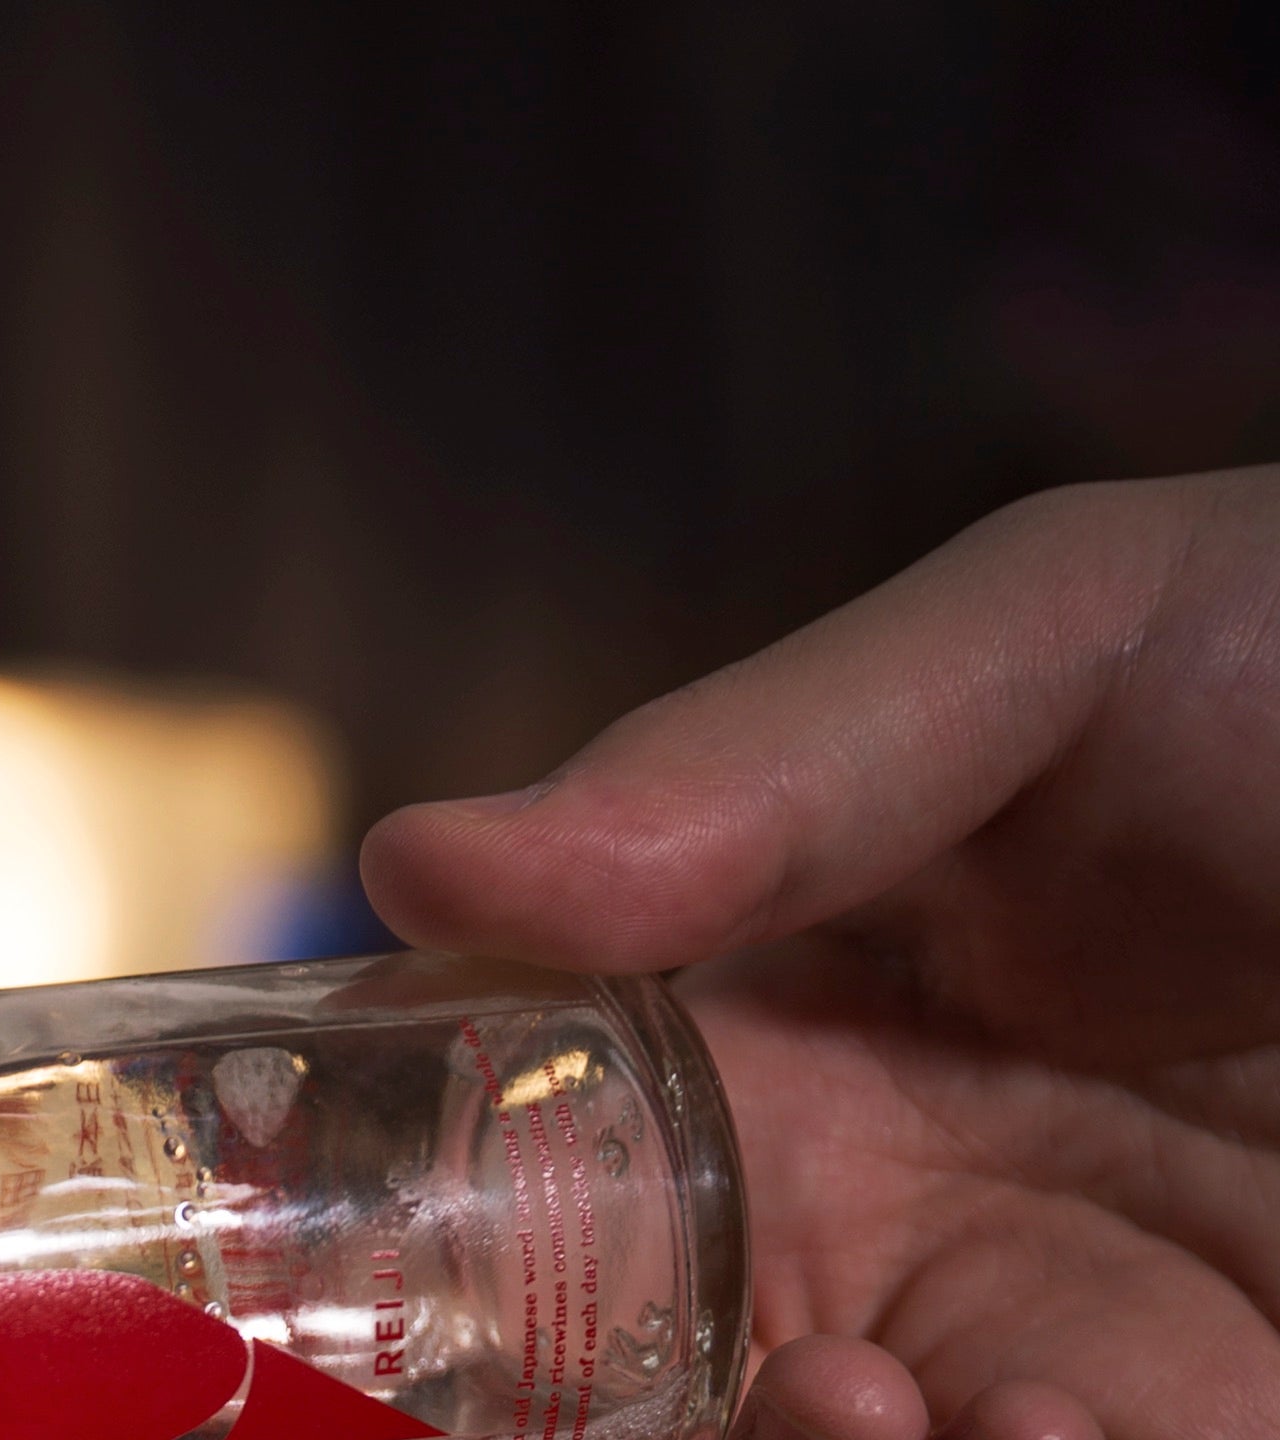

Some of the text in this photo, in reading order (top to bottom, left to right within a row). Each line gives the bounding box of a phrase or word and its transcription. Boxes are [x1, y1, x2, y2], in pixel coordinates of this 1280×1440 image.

[478, 1052, 502, 1106] whole
[500, 1111, 509, 1123] a
[557, 1103, 575, 1147] with
[571, 1155, 593, 1248] together
[518, 1228, 534, 1287] word
[582, 1254, 597, 1294] day
[373, 1248, 403, 1377] REIJI
[551, 1280, 565, 1385] ricewines
[583, 1301, 596, 1352] each
[520, 1292, 536, 1391] Japanese
[582, 1357, 592, 1379] of
[515, 1397, 529, 1428] old
